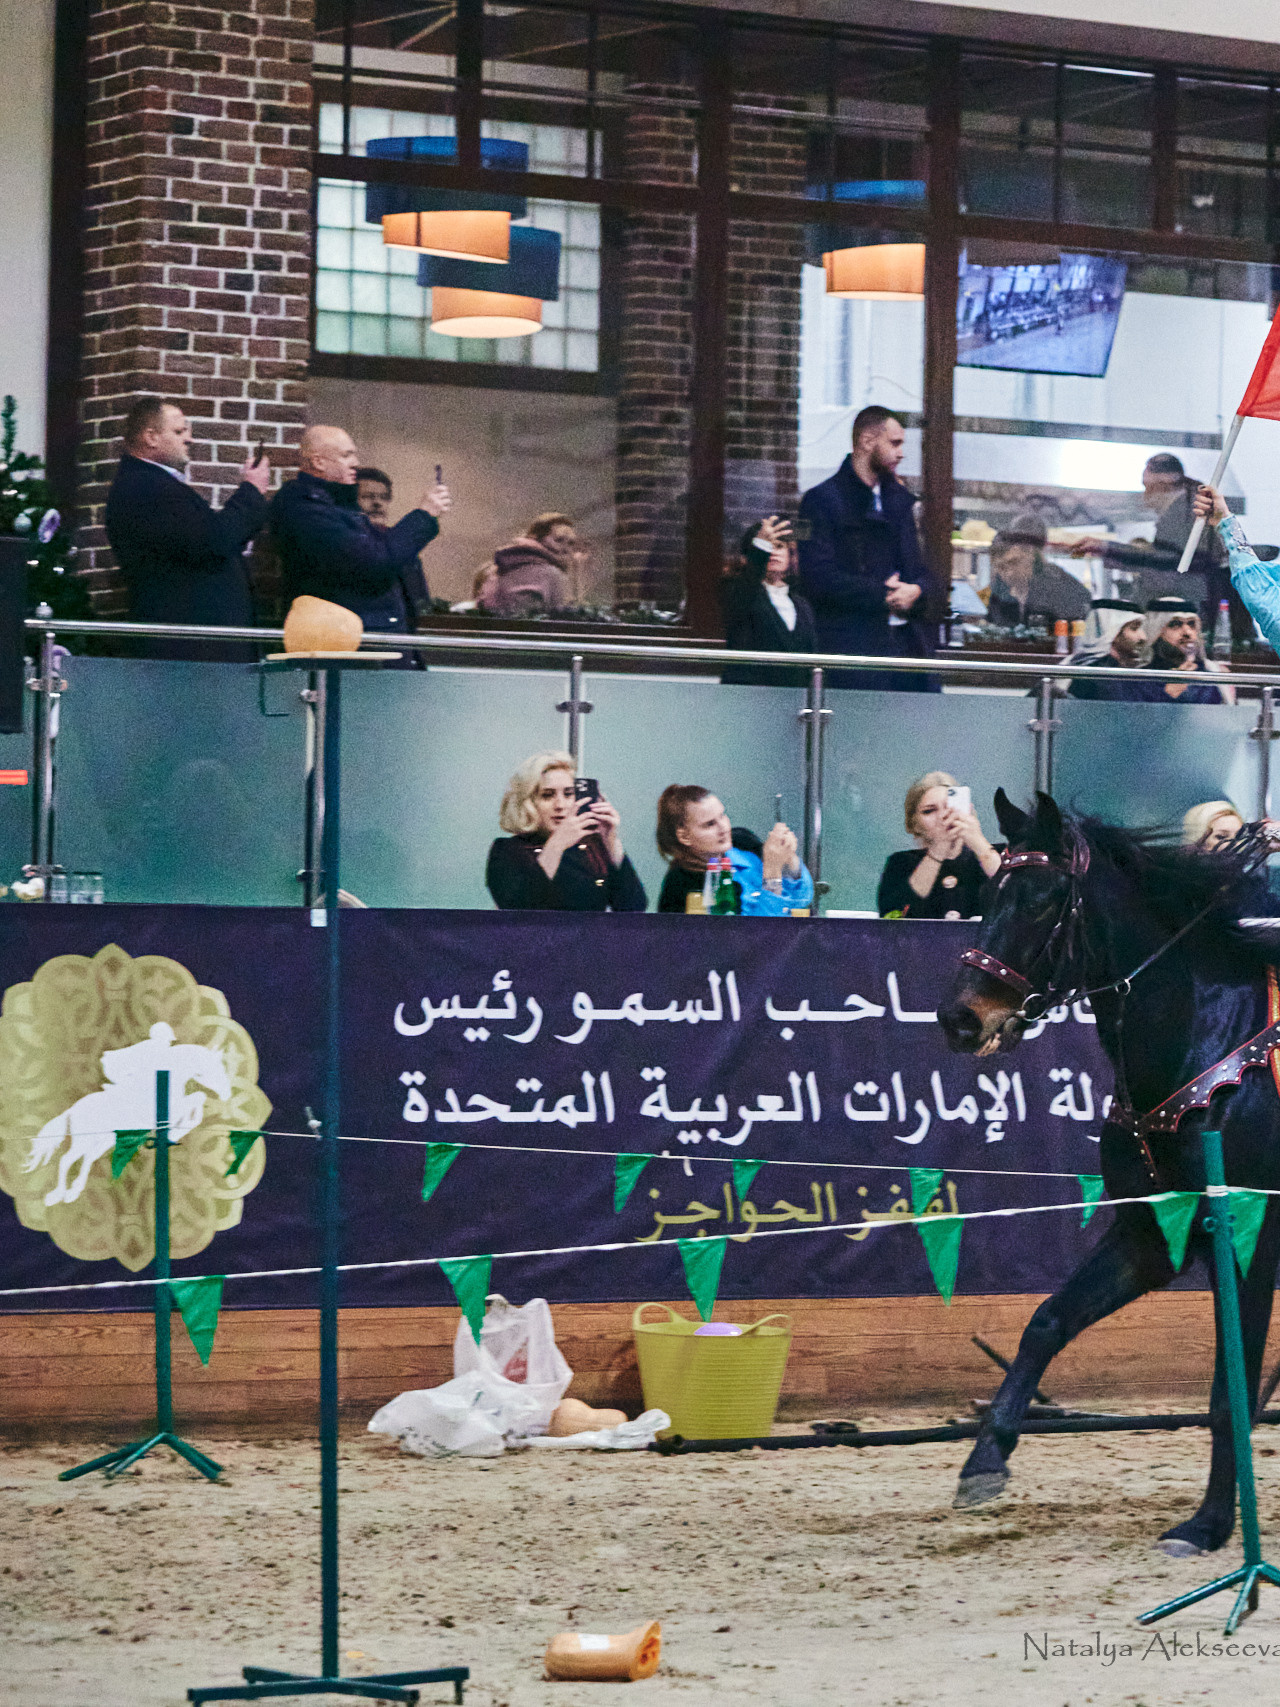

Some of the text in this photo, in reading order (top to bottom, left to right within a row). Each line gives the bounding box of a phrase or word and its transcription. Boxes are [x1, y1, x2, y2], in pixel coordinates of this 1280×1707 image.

[394, 969, 543, 1045] رئيس
[553, 969, 741, 1045] السمو
[765, 970, 938, 1040] احب
[399, 1070, 615, 1129] المتحدة
[640, 1066, 821, 1146] العربية
[844, 1069, 1026, 1144] الإمارات
[635, 1181, 837, 1243] الحواجز
